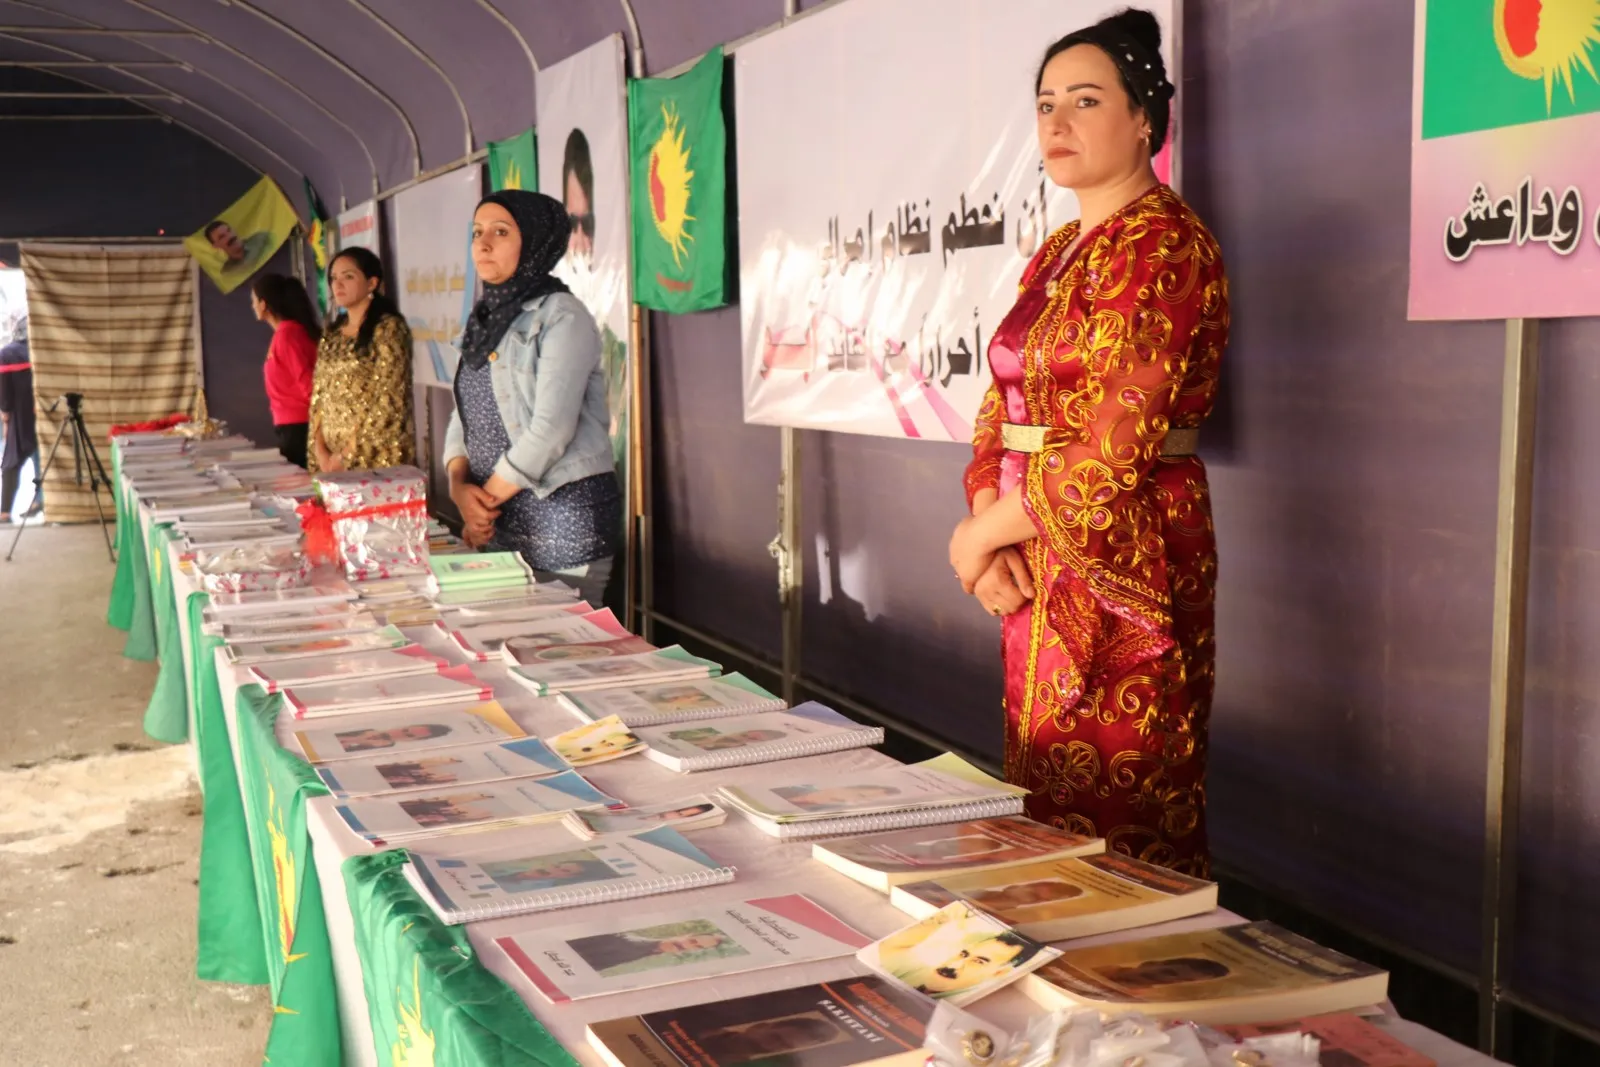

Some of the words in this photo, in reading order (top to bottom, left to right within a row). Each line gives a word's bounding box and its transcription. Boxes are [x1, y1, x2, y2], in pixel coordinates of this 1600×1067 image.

[880, 198, 931, 274] نظام
[941, 191, 1005, 268] نحطم
[1445, 178, 1582, 260] وداعش
